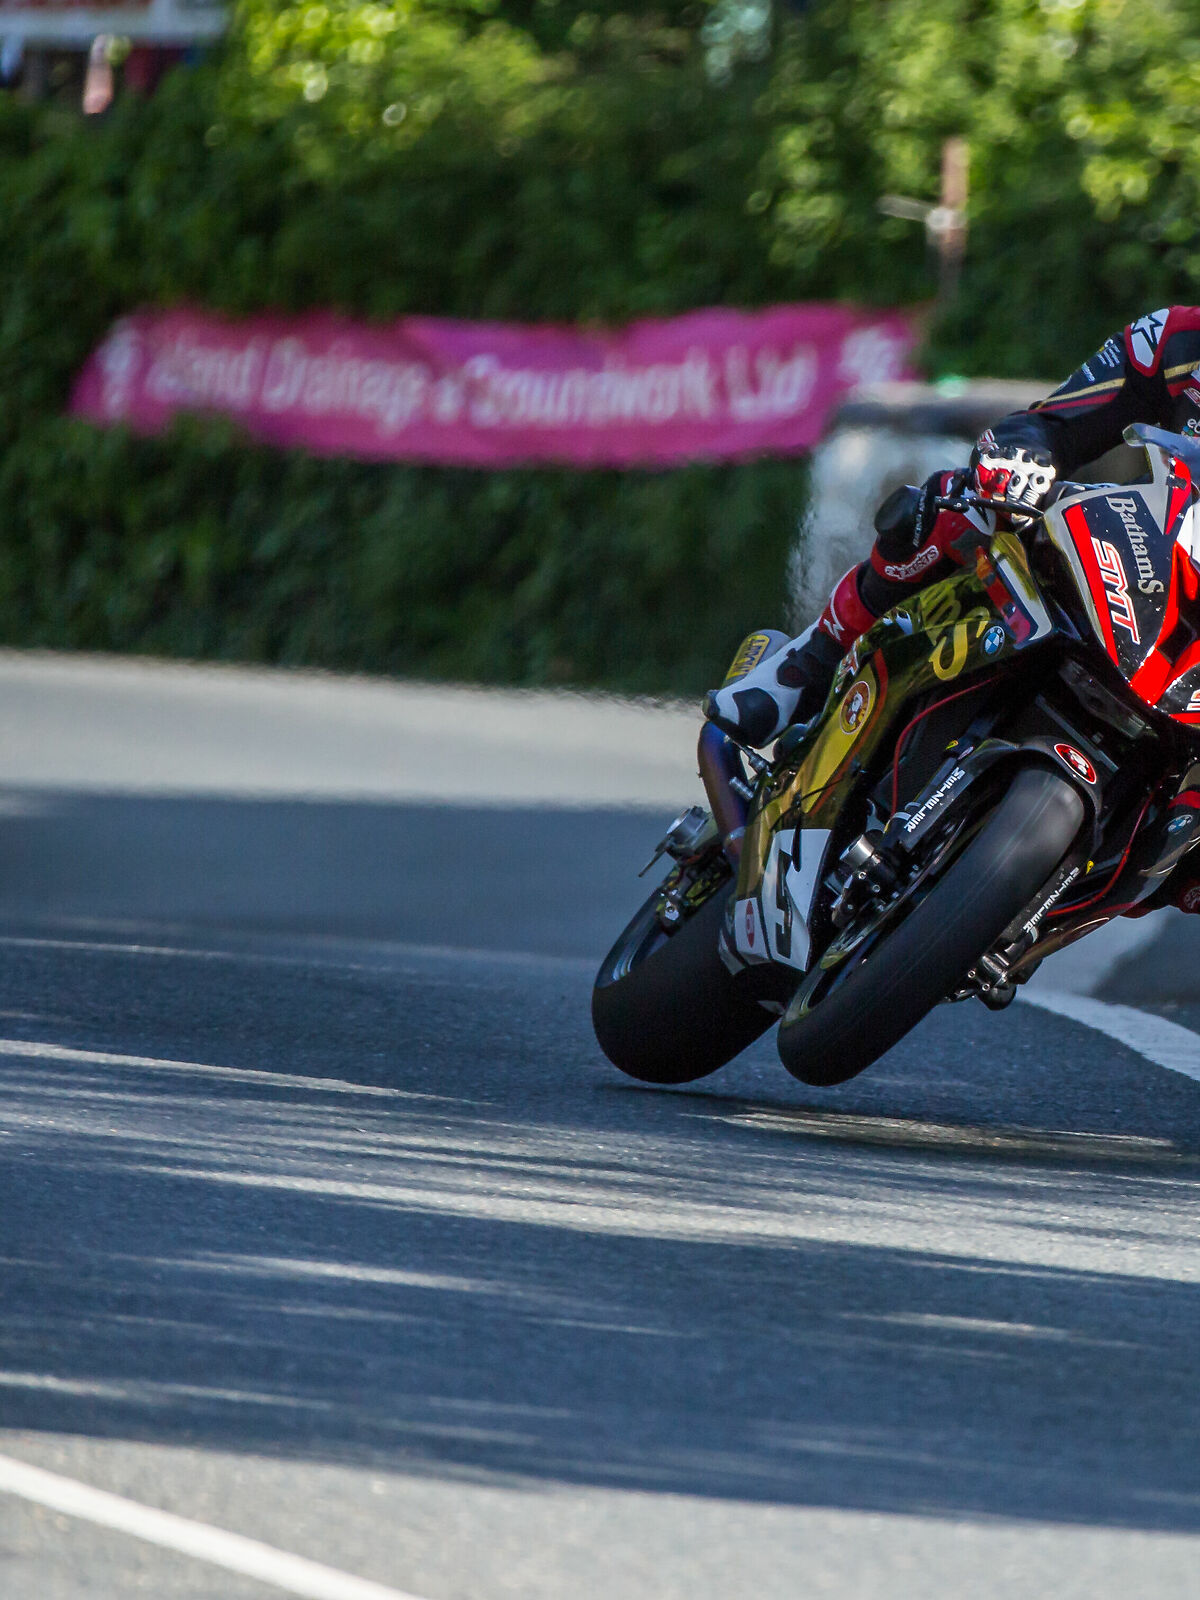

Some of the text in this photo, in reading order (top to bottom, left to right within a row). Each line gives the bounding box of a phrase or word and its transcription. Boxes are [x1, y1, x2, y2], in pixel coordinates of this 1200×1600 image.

[1091, 536, 1141, 645] SMT
[903, 766, 966, 833] METZELER
[1023, 867, 1080, 934] METZELER
